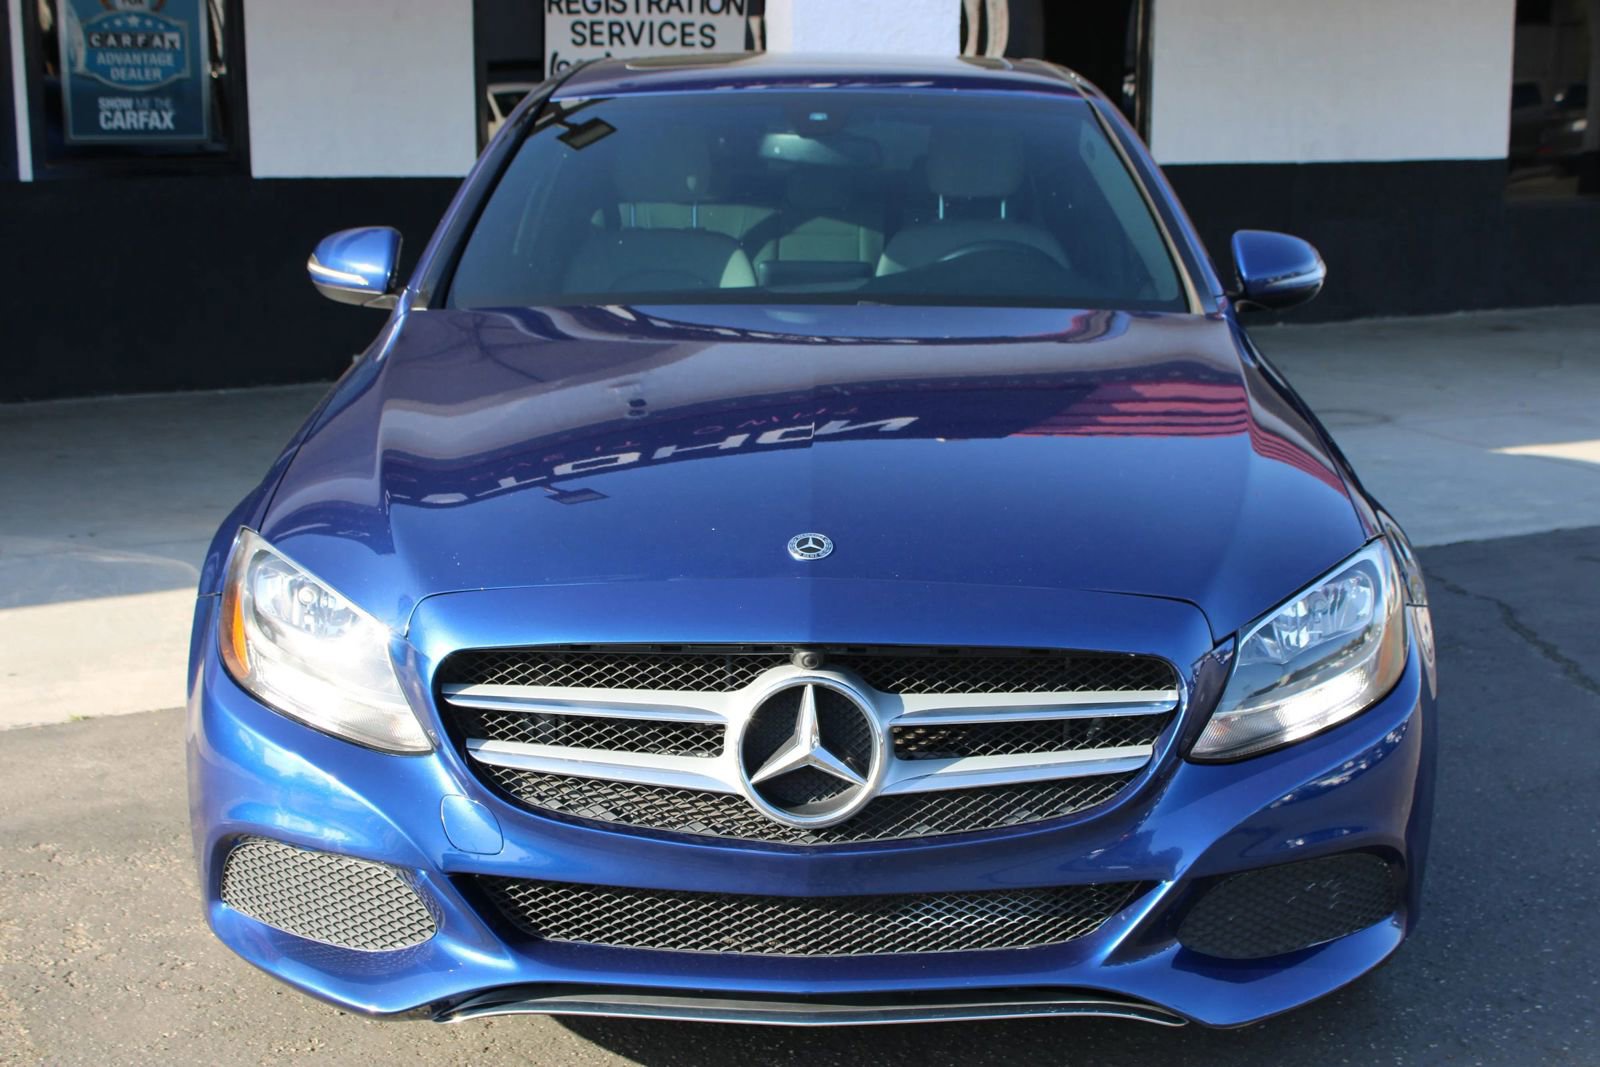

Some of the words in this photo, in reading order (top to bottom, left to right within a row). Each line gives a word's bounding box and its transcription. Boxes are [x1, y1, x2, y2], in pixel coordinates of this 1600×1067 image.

[547, 0, 745, 15] REGISTRATION
[571, 20, 717, 48] SERVICES
[98, 52, 173, 66] ADVANTAGE
[111, 67, 161, 80] DEALER
[99, 97, 132, 110] SHOW
[99, 111, 175, 130] CARFAX
